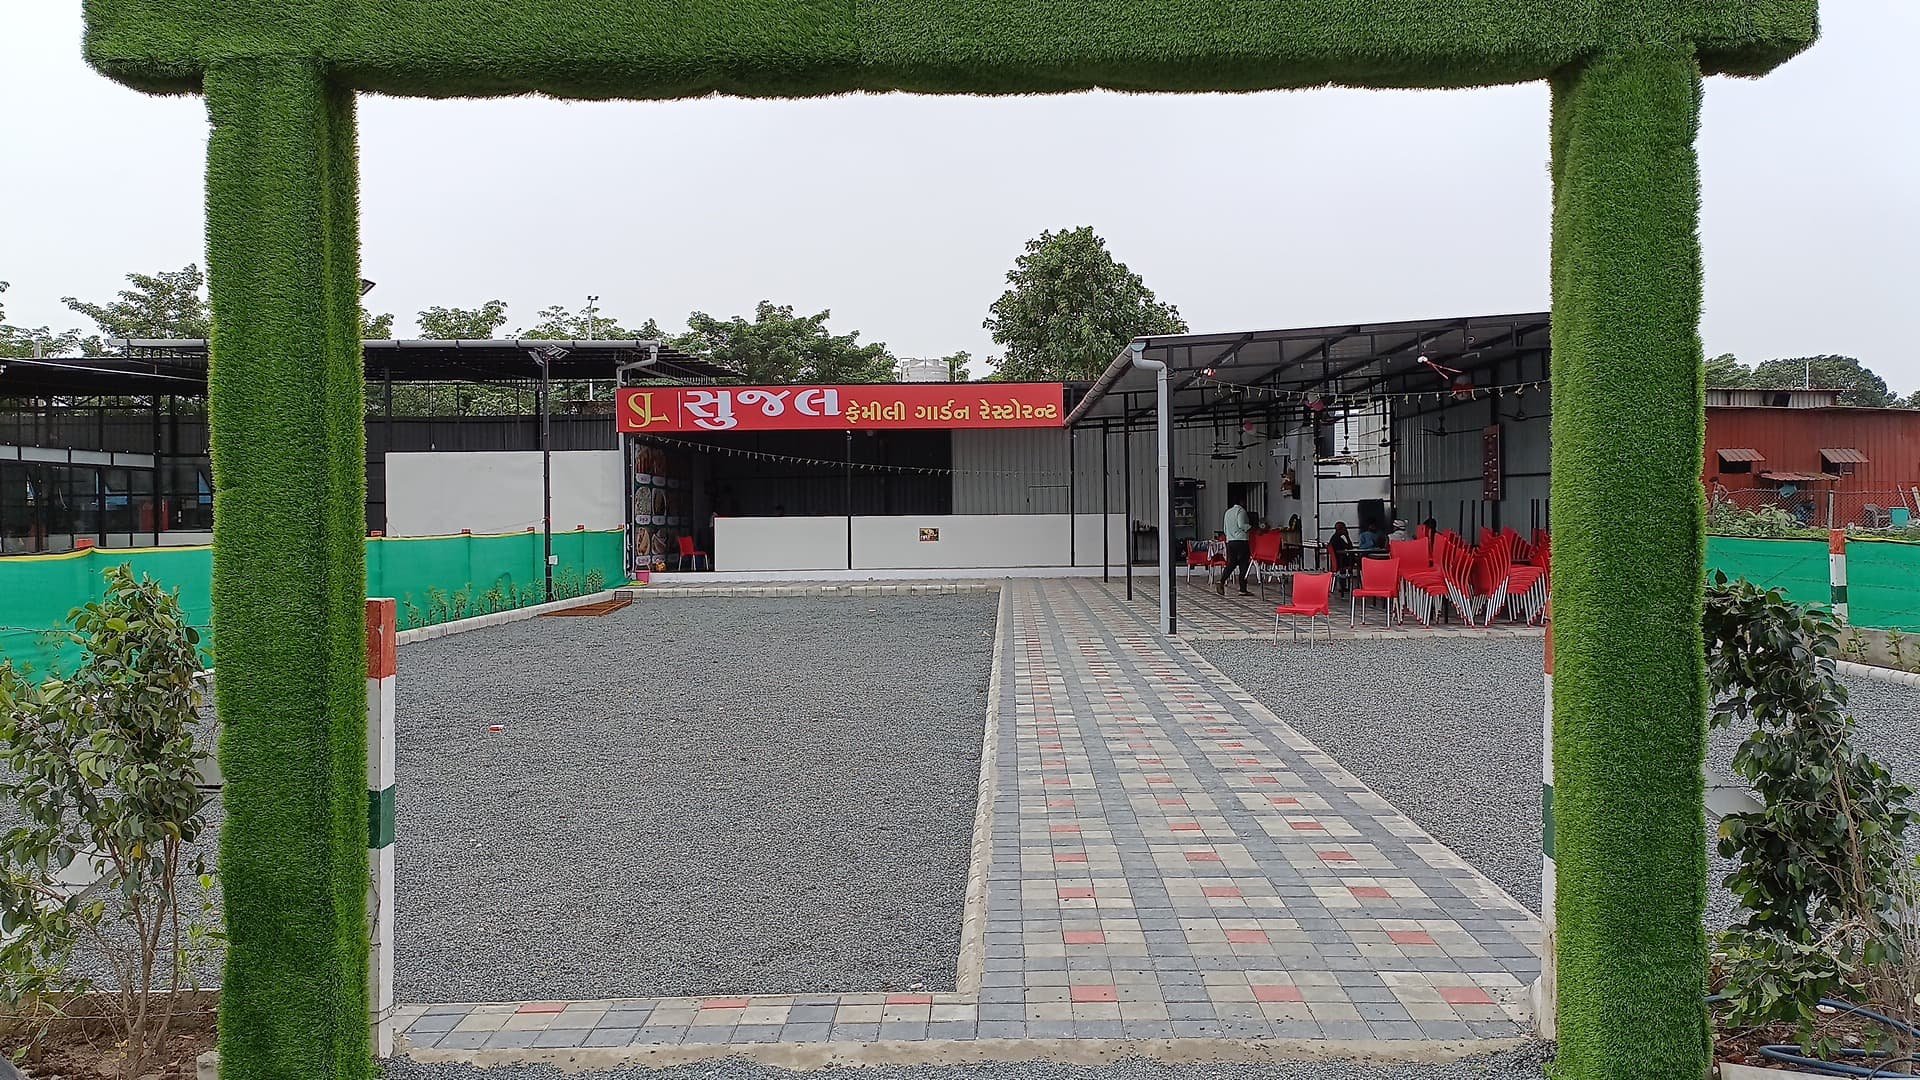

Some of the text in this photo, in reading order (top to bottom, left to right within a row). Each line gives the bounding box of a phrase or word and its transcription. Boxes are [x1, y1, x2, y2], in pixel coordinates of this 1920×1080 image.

[684, 389, 1058, 430] સુજલ ફેમીલી ગાર્ડન રેસ્ટોરન્ટ
